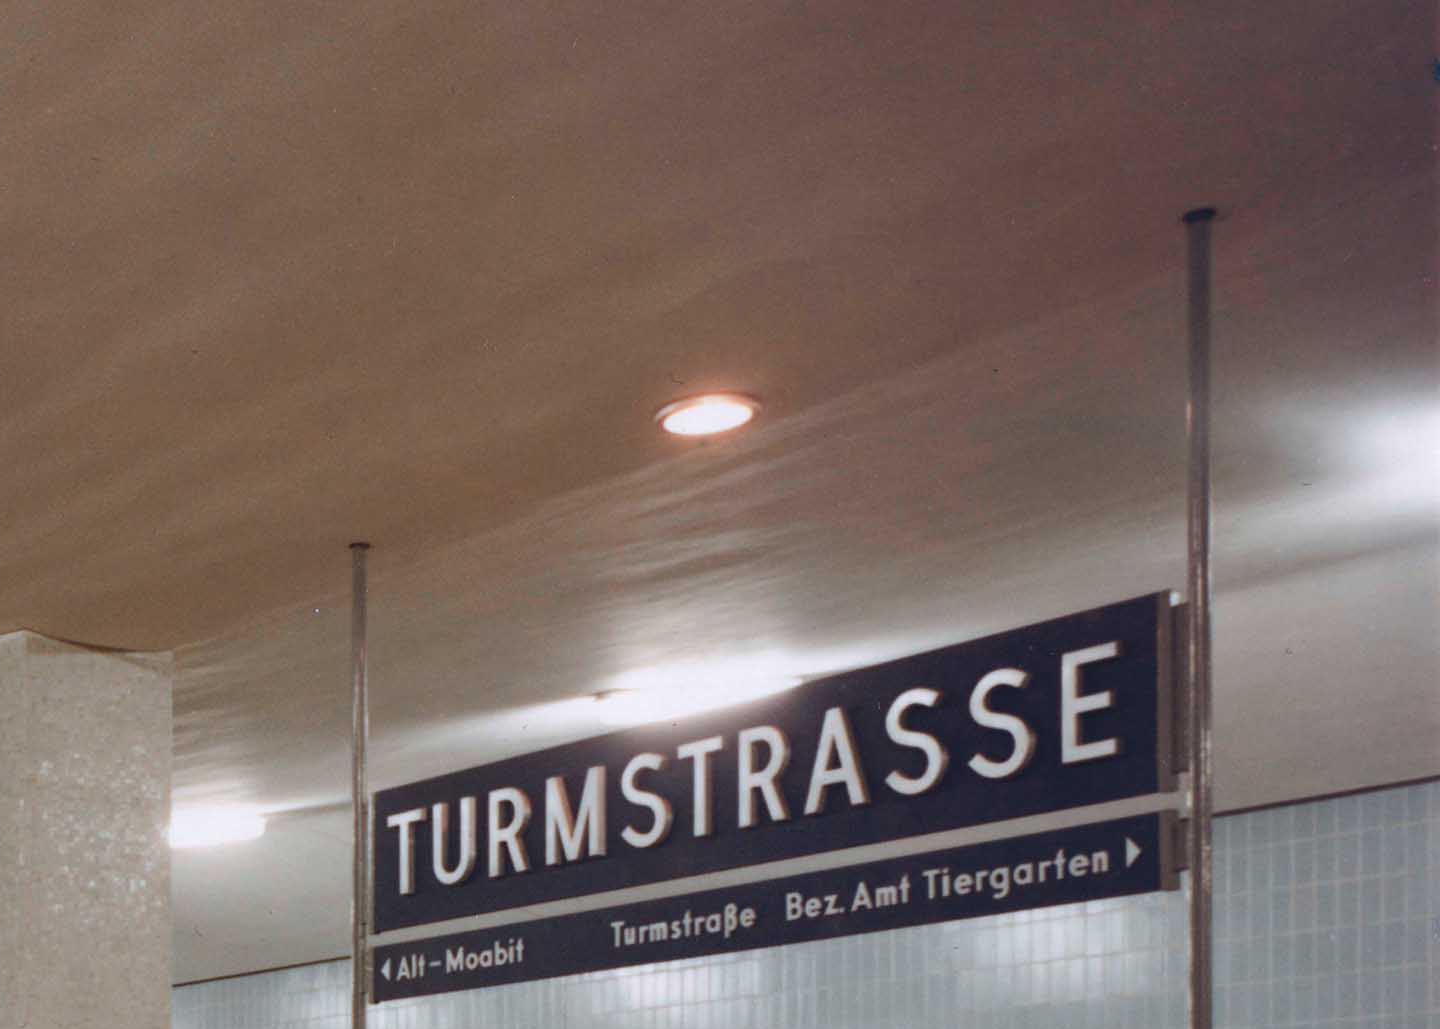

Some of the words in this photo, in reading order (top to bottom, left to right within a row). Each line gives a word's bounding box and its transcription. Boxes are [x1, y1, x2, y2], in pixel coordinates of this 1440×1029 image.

[386, 641, 1122, 895] TURMSTRASSE
[610, 902, 758, 949] Turmstraße
[922, 848, 1109, 900] Tiergarten
